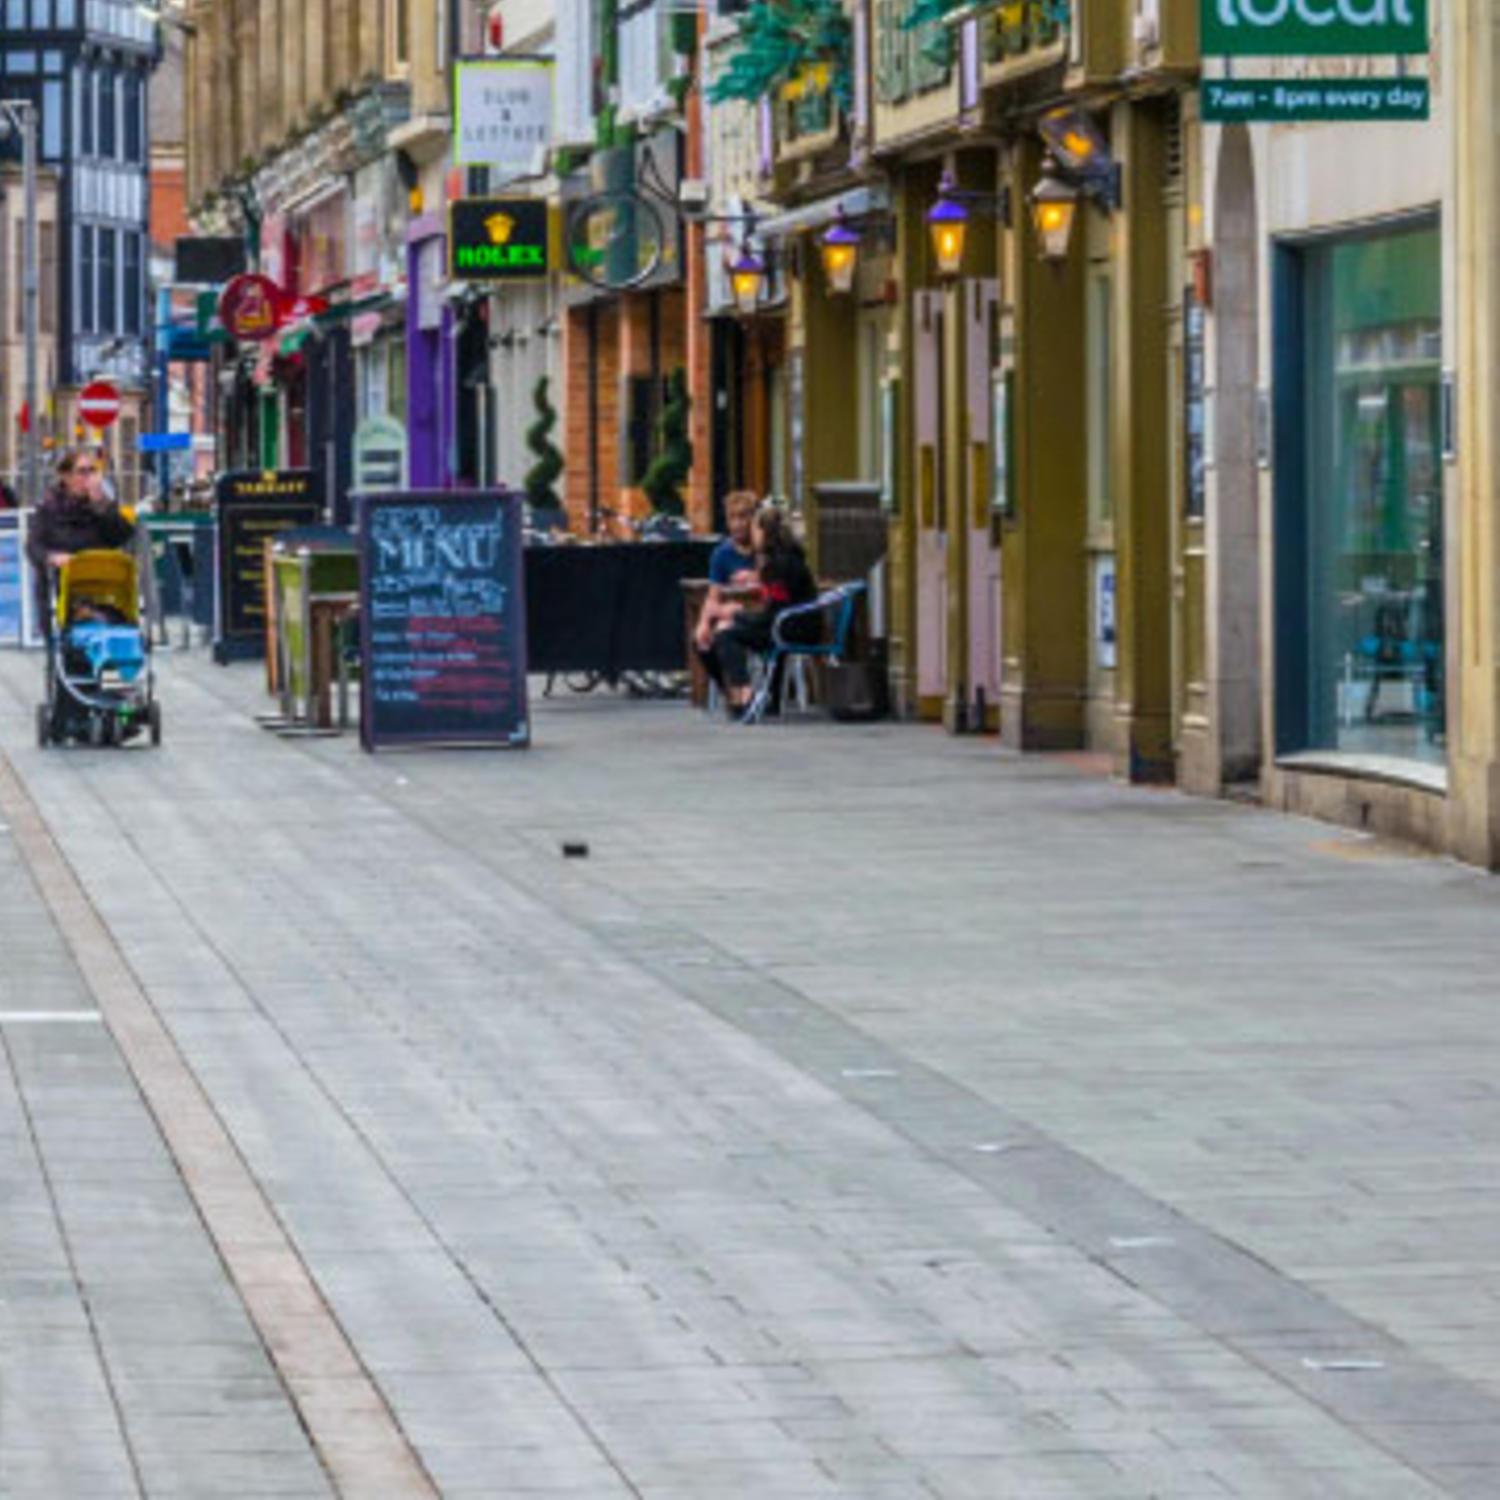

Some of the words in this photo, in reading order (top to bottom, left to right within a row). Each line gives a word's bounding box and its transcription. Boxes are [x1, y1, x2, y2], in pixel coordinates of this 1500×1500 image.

[1207, 86, 1256, 108] 7am
[1324, 90, 1381, 110] every
[1386, 85, 1424, 109] day
[457, 245, 544, 268] ROLEX
[379, 537, 498, 570] MENU
